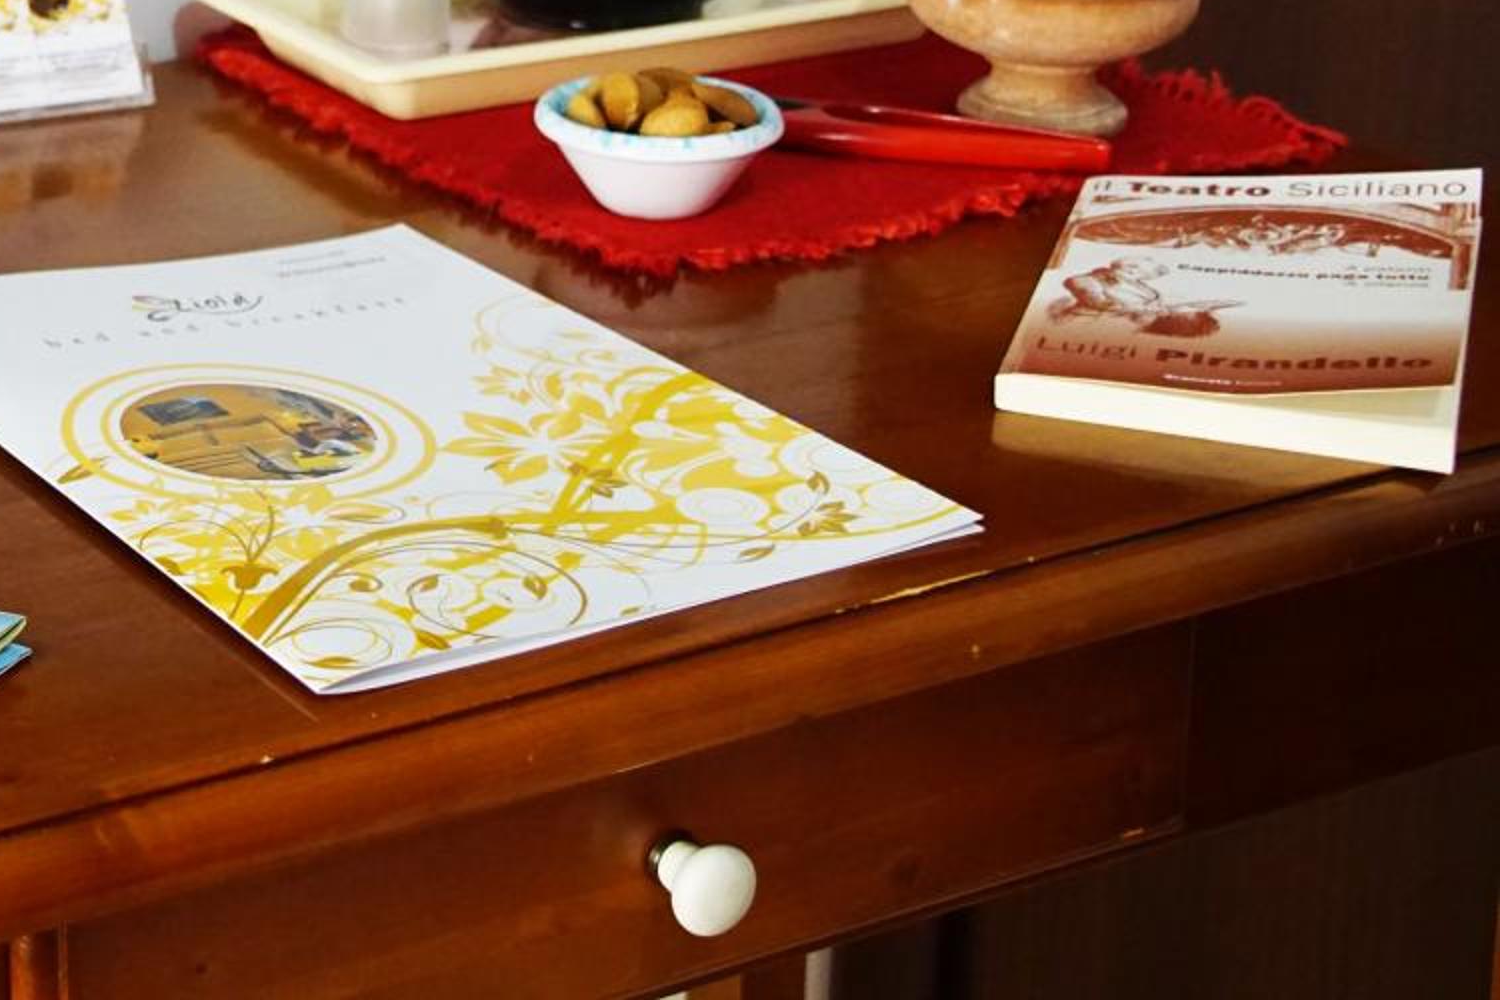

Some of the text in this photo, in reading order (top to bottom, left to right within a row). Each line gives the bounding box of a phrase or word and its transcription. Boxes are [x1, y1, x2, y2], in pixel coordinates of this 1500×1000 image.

[1128, 181, 1271, 197] Teatro
[1286, 180, 1468, 198] Siciliano
[1035, 335, 1433, 370] Luigi Pirandello
